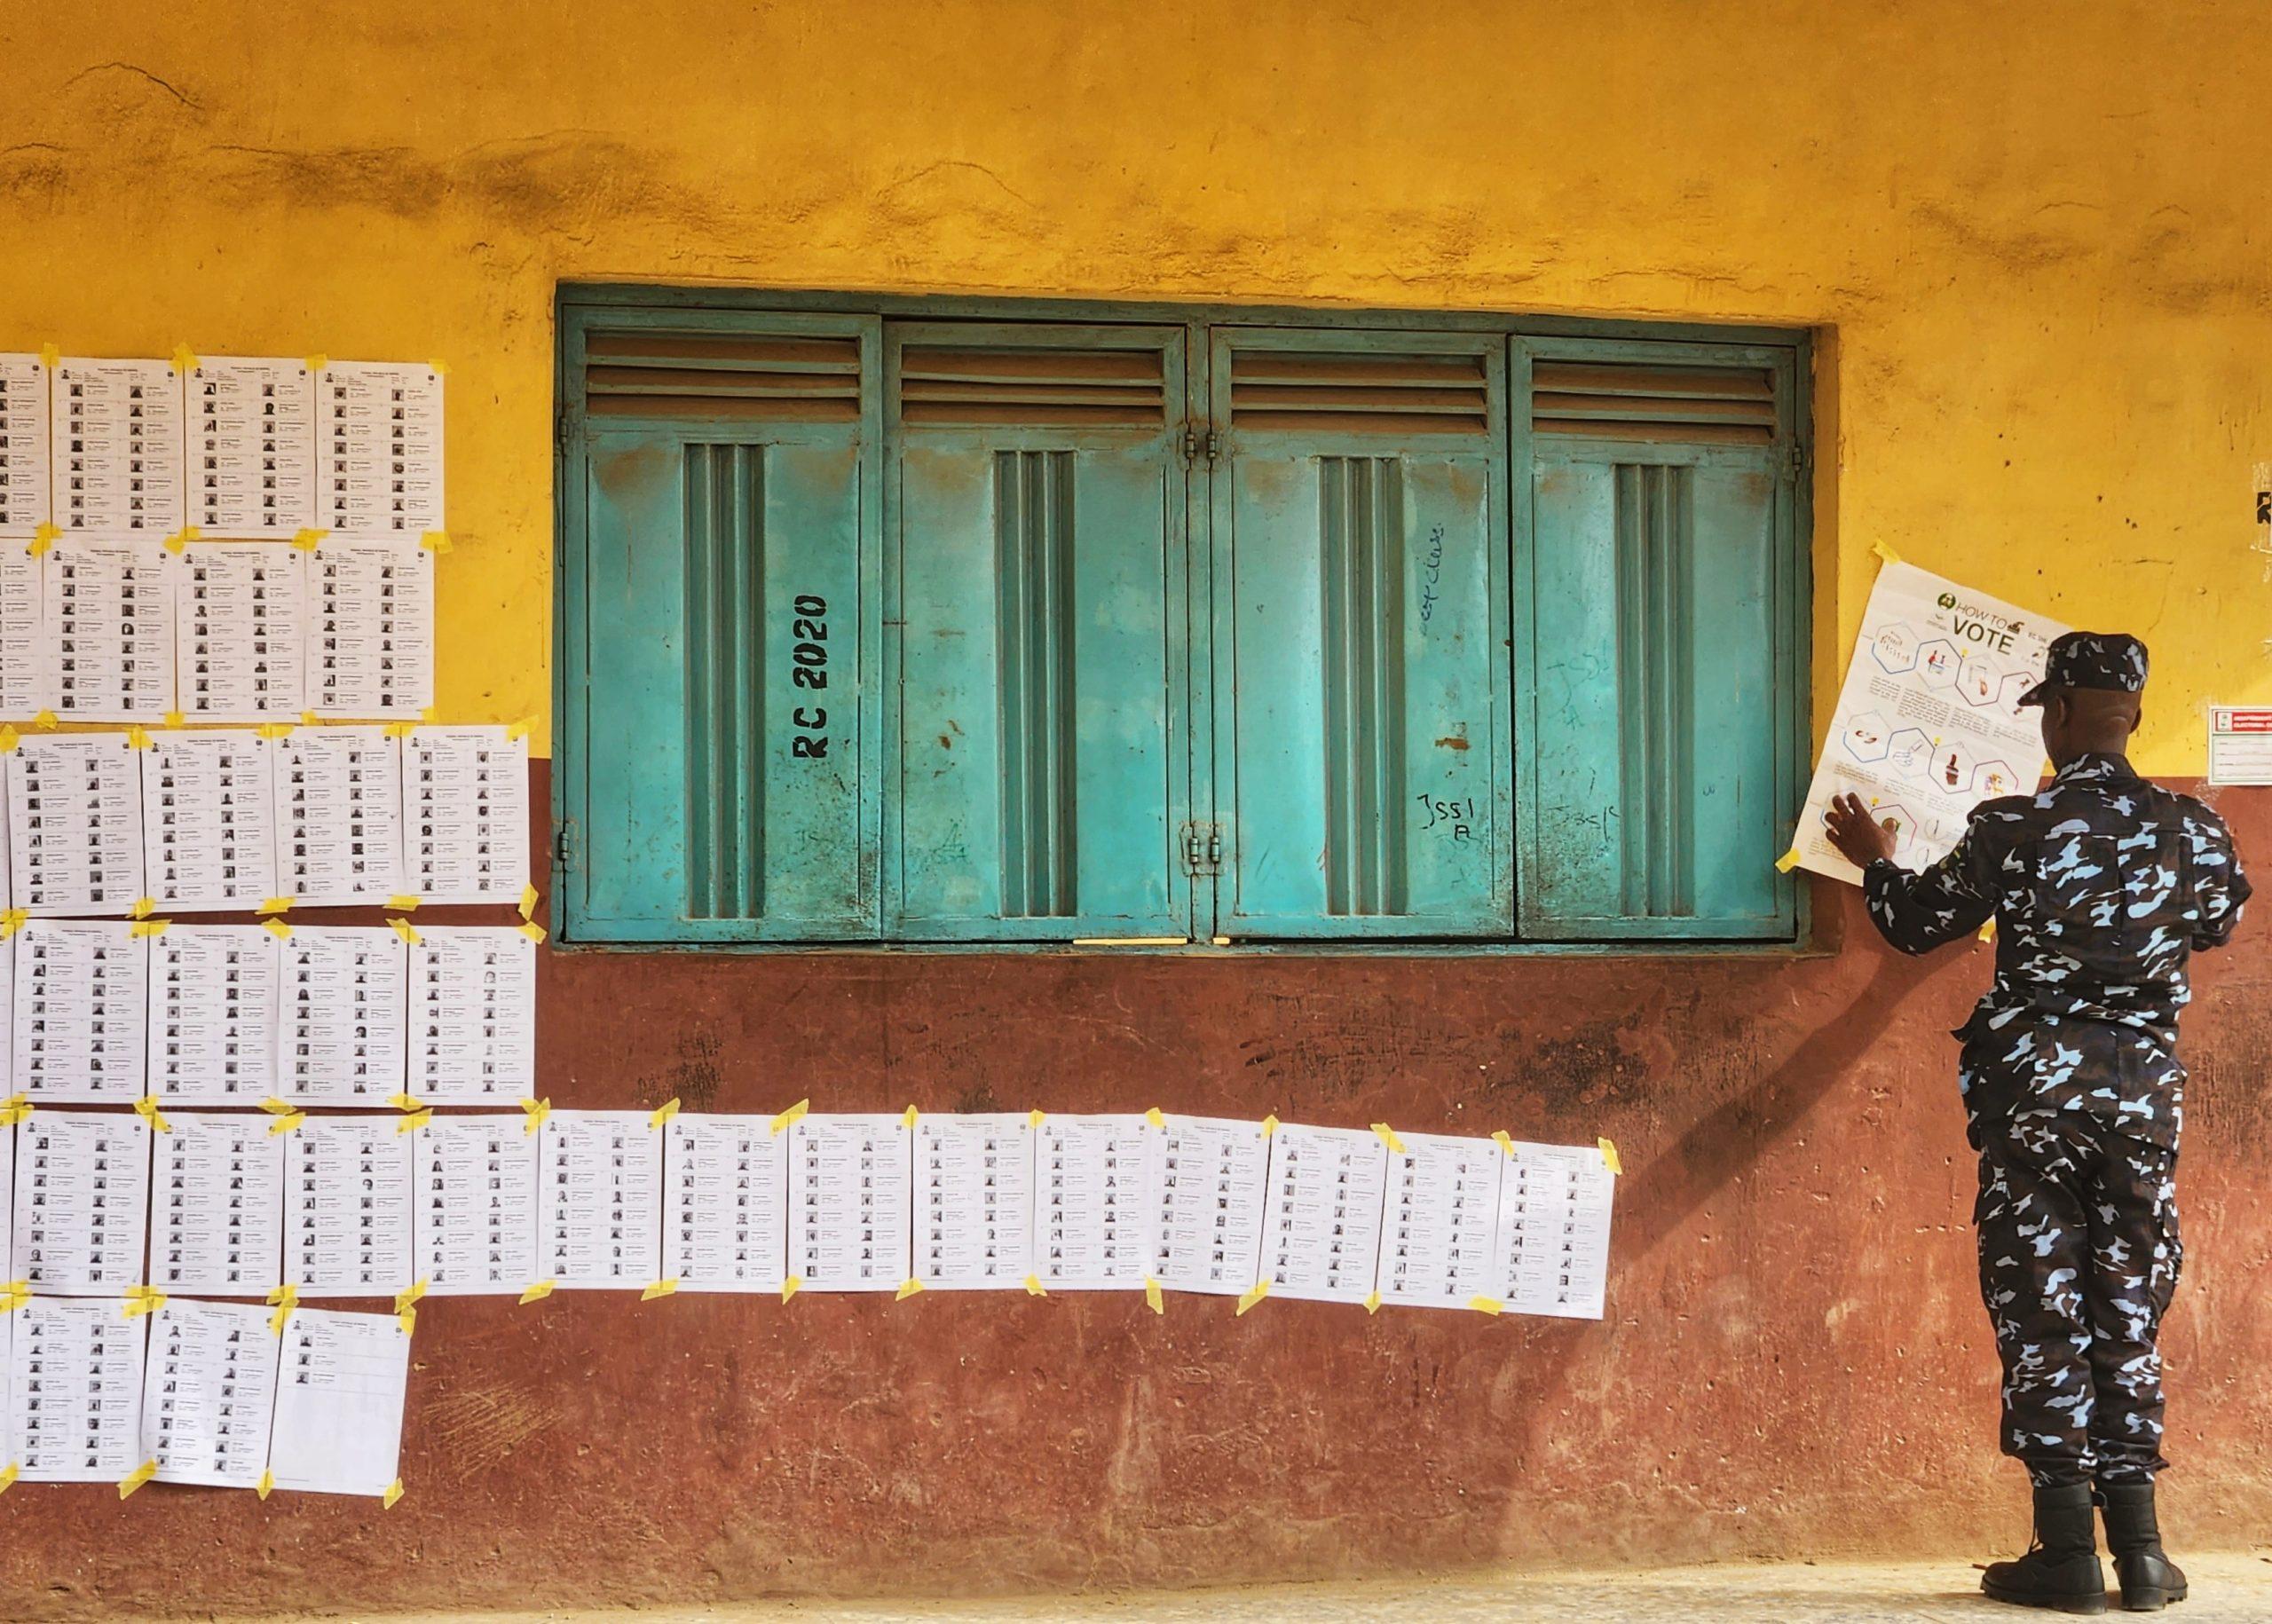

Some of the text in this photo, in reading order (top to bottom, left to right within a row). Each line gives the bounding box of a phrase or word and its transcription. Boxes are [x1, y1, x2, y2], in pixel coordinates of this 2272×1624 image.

[1953, 615, 2015, 656] VOTE
[1955, 602, 2008, 629] HOW TO
[793, 595, 828, 759] RC 2020
